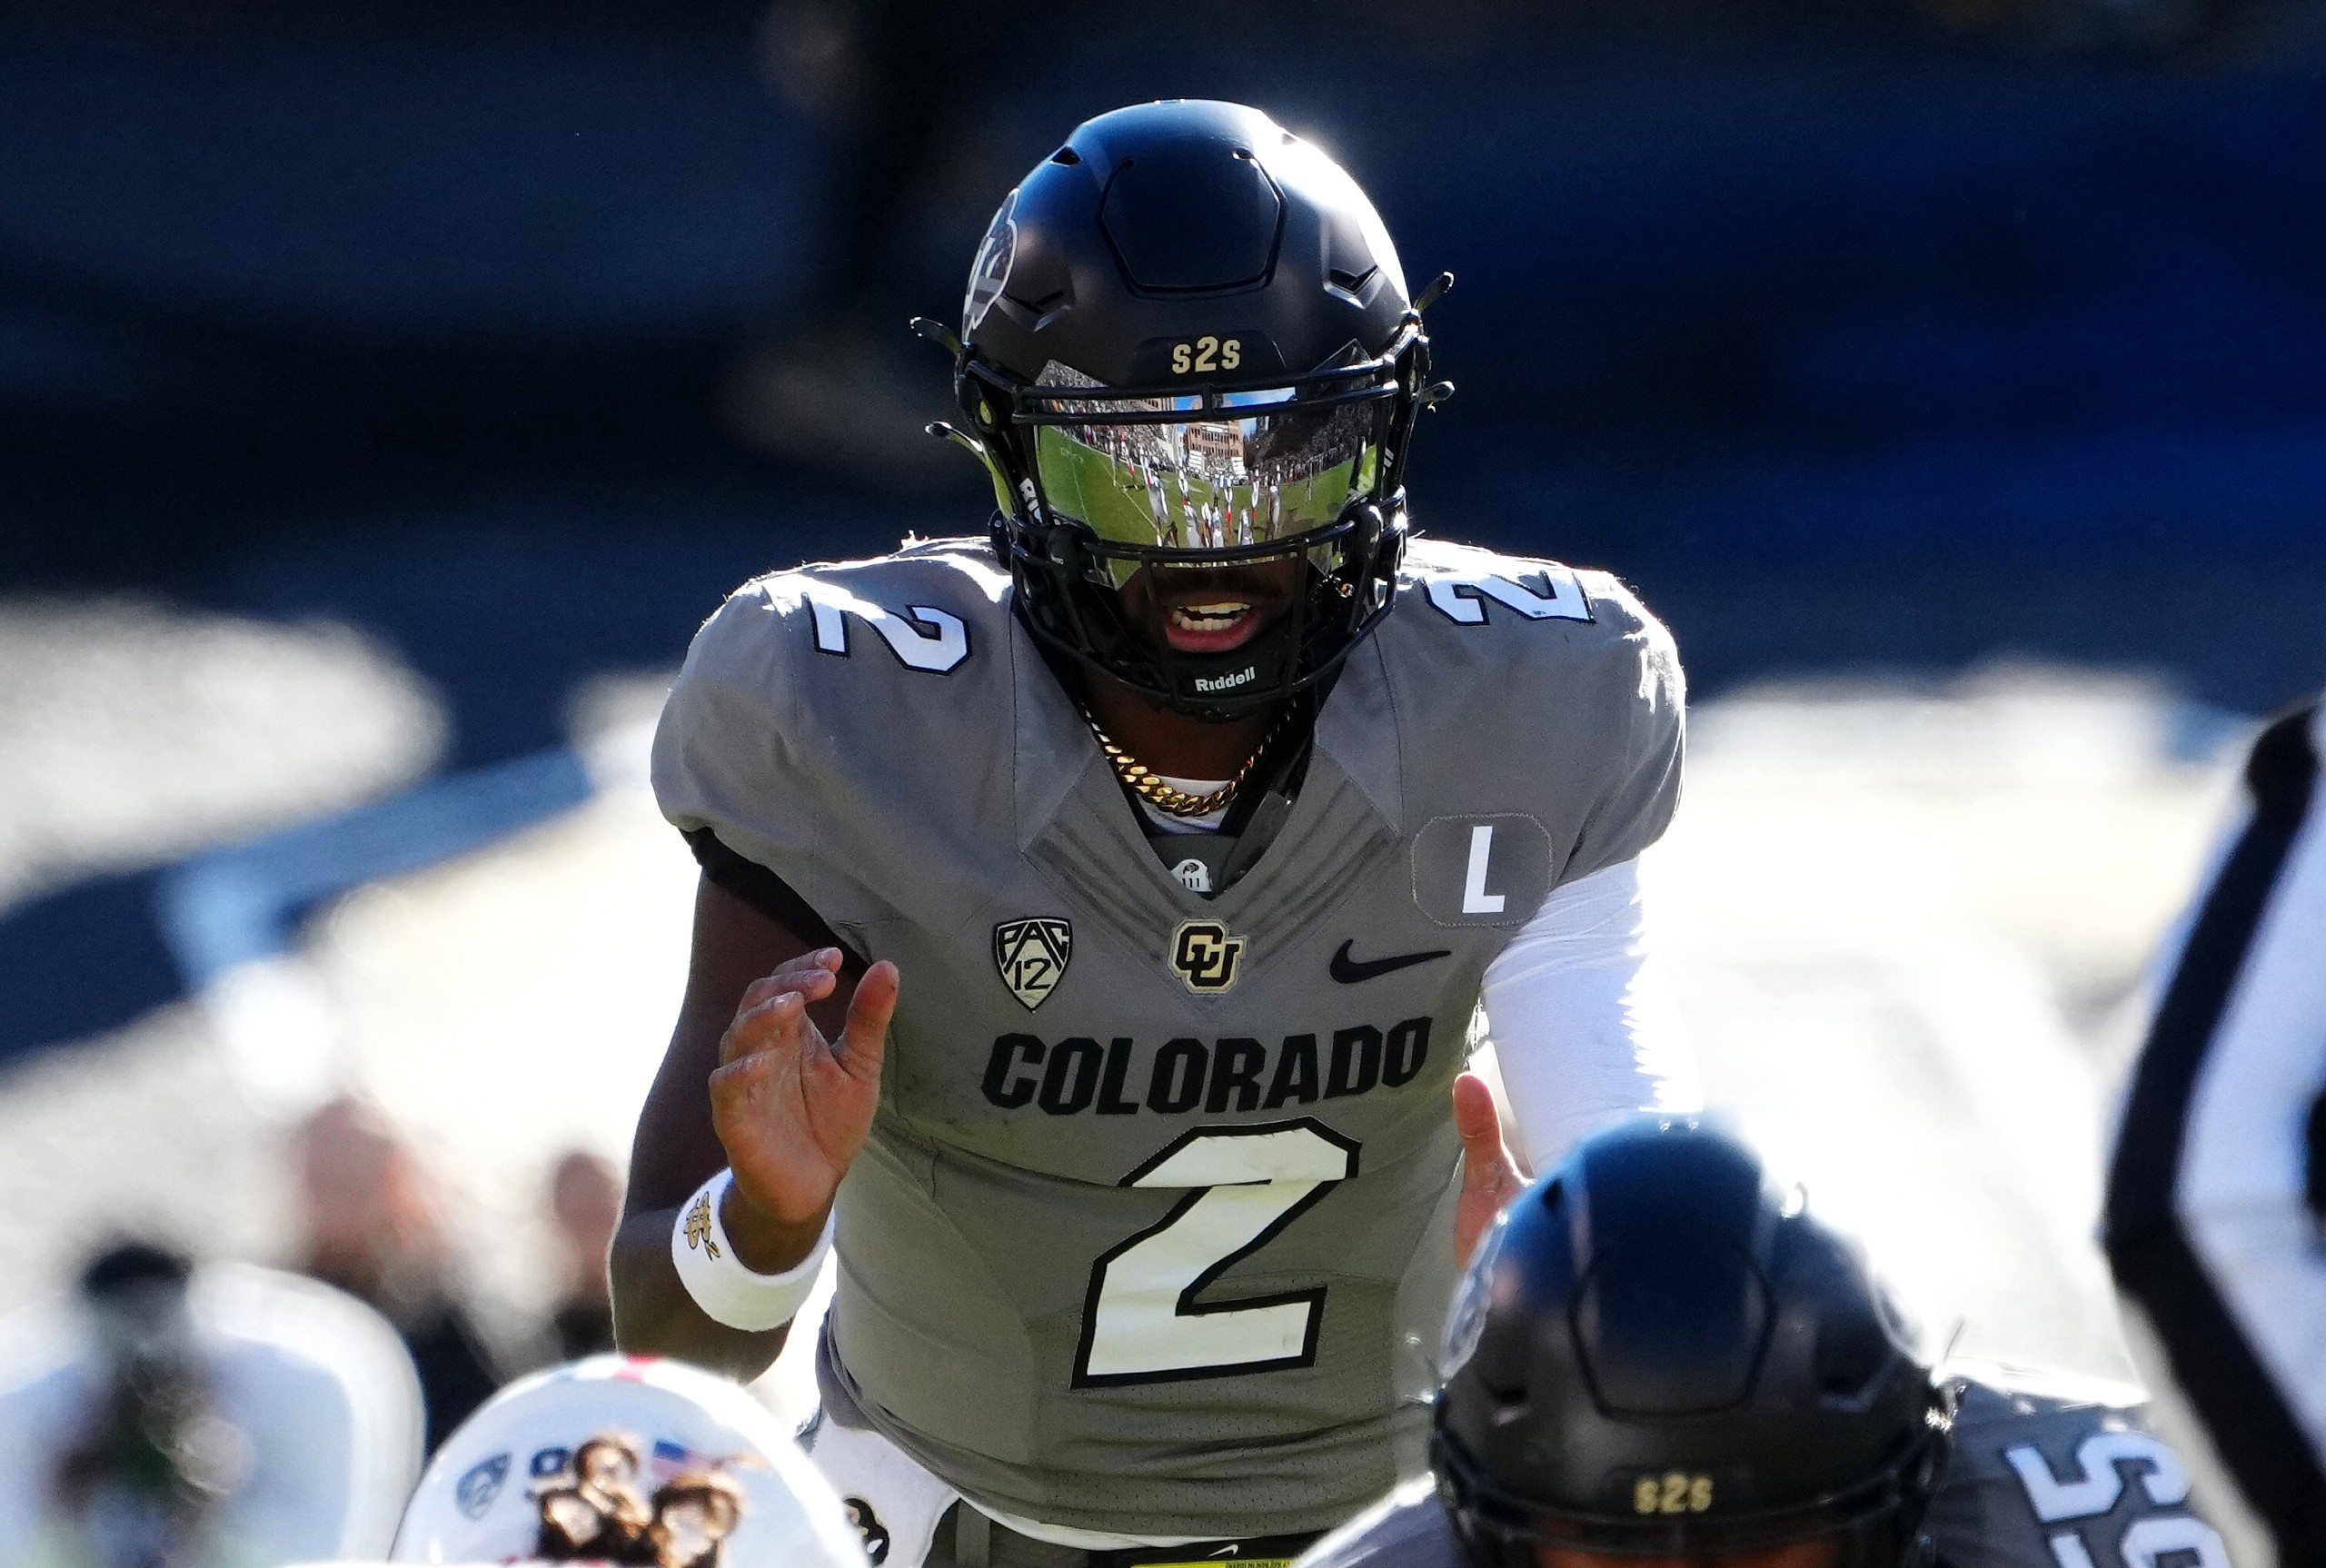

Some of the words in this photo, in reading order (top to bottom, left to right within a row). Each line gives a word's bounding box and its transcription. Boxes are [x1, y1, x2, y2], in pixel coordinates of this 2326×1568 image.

[1171, 335, 1241, 374] s2s
[1420, 569, 1596, 627] 2
[802, 592, 972, 676] 2
[1194, 666, 1256, 692] Riddell
[1462, 825, 1506, 914] L
[997, 919, 1070, 975] PAC
[1014, 958, 1052, 991] 12
[1172, 920, 1245, 993] CU
[979, 1016, 1434, 1116] COLORADO
[1069, 1115, 1363, 1390] 2
